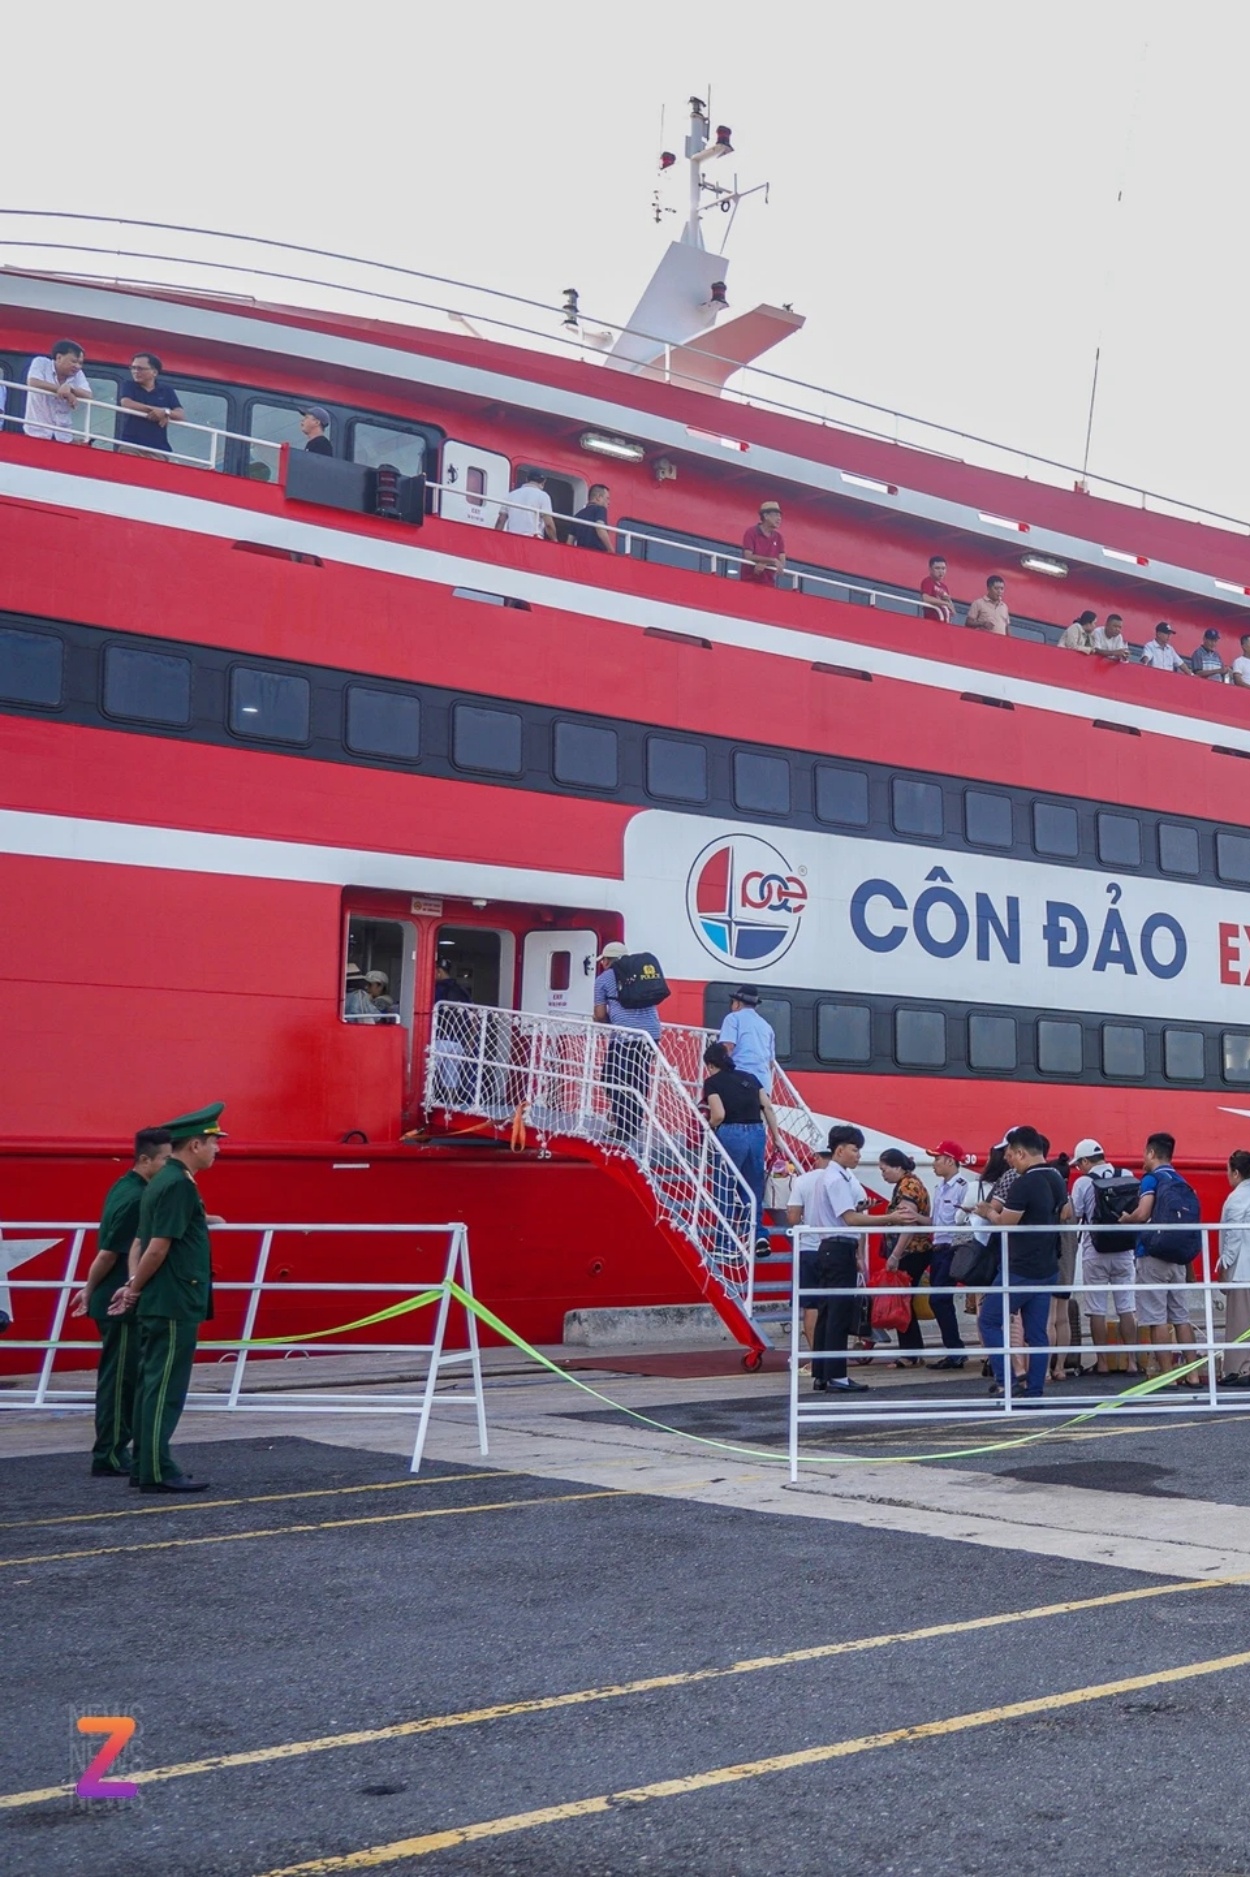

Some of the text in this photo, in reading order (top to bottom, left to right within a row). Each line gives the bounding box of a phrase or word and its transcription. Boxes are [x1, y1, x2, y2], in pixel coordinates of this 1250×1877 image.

[849, 865, 1021, 965] CÔN
[1042, 882, 1188, 980] ĐẢO
[964, 1153, 978, 1165] 30
